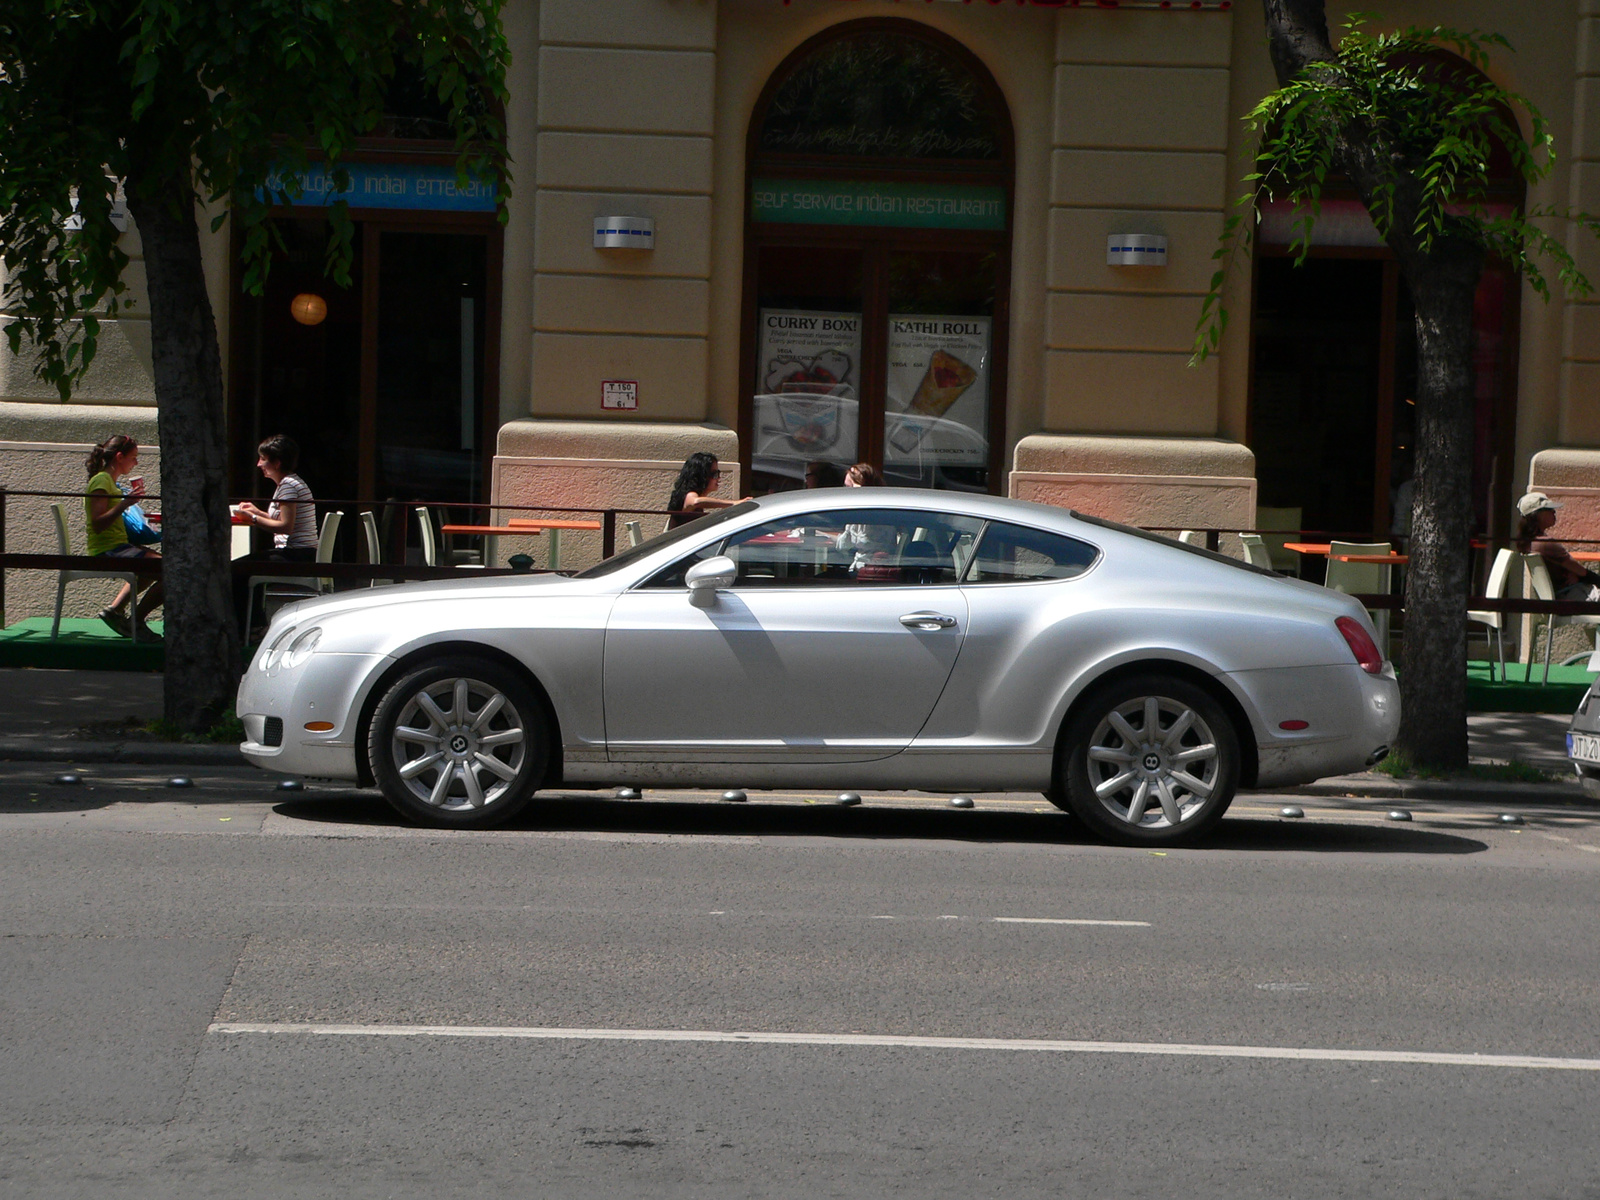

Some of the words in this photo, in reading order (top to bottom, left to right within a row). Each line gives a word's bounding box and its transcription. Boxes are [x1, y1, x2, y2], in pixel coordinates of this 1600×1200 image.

[767, 316, 818, 329] CURRY
[822, 319, 857, 331] BOX!
[894, 321, 937, 334] KATHI
[943, 323, 981, 335] ROLL
[609, 383, 615, 391] T
